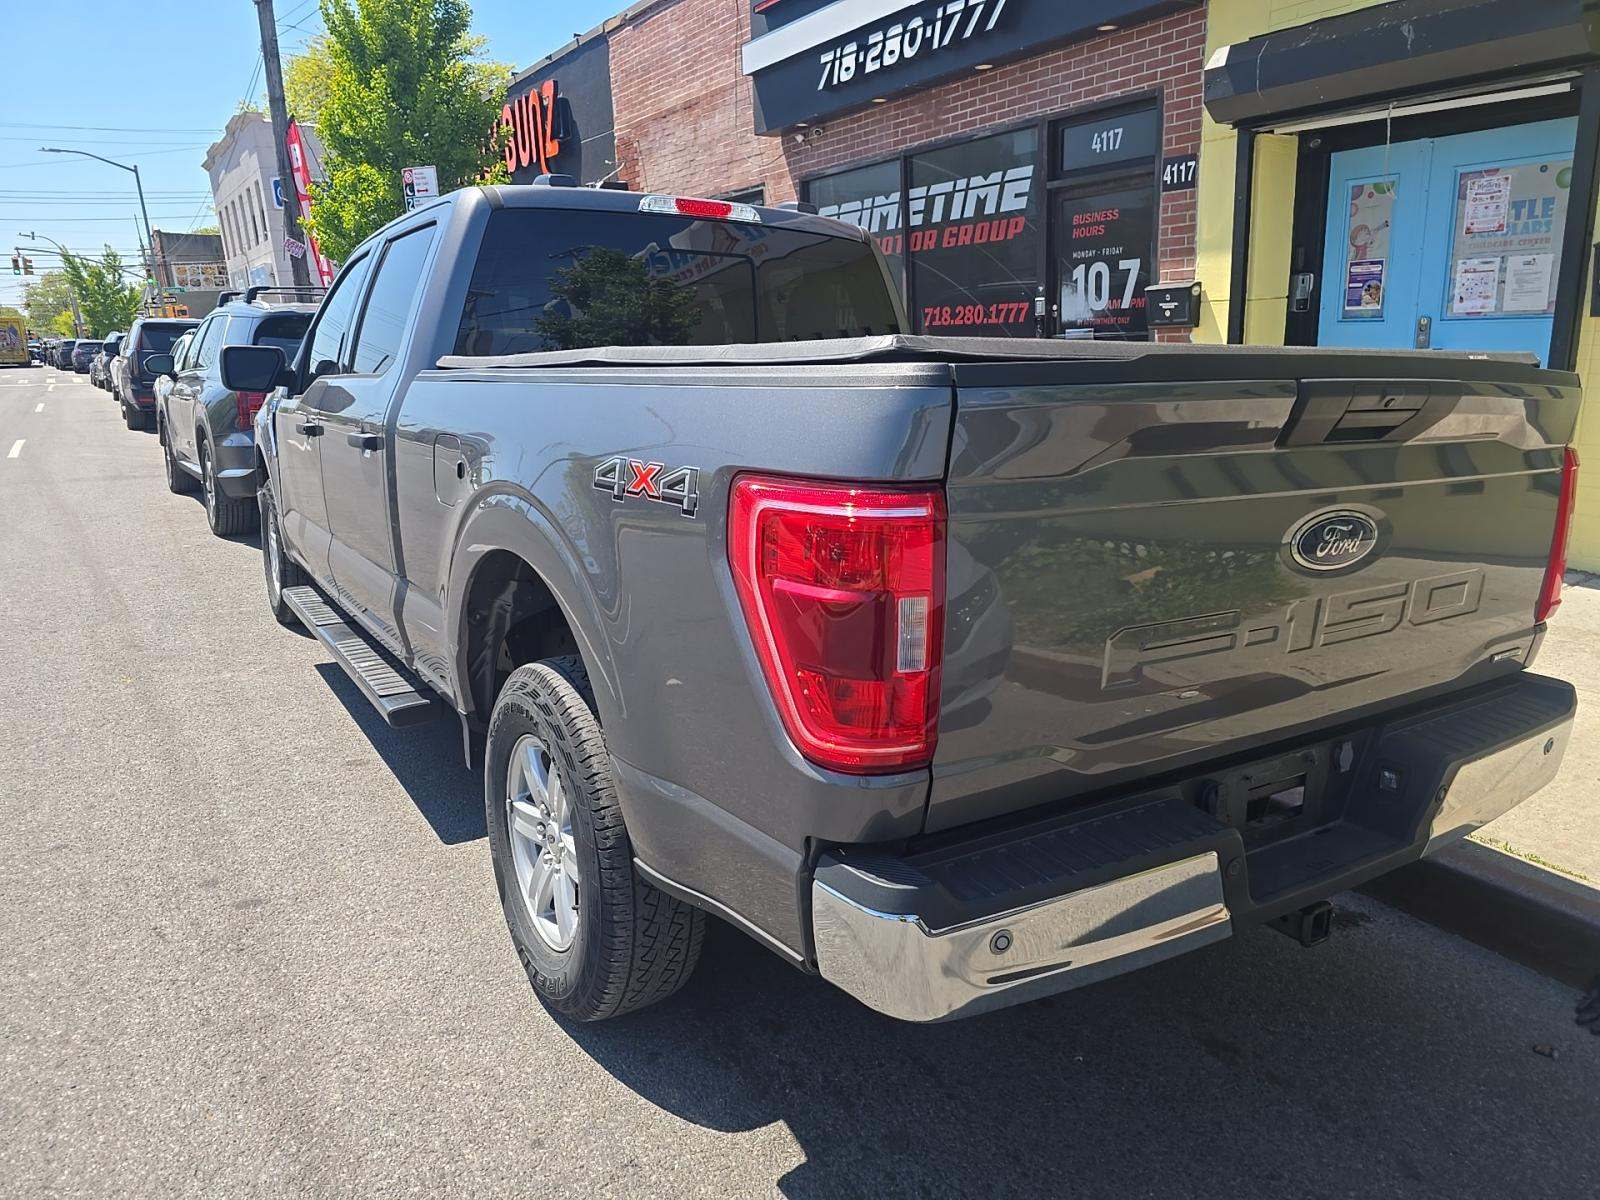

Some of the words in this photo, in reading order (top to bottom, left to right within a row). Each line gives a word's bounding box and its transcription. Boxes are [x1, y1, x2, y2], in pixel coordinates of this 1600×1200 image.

[1091, 127, 1123, 153] 4117
[1163, 160, 1196, 185] 4117
[1073, 209, 1119, 225] BUSINESS
[1511, 196, 1556, 221] TLE
[874, 228, 938, 256] OTOR
[942, 216, 1026, 248] GROUP
[1073, 225, 1105, 239] HOURS
[1073, 250, 1096, 259] MONDAY
[1102, 247, 1123, 256] FRIDAY
[1072, 261, 1110, 311] 10
[1119, 258, 1141, 309] 7
[924, 302, 1030, 327] 718.280.1777
[1316, 524, 1364, 558] Ford
[1100, 568, 1486, 690] F-150
